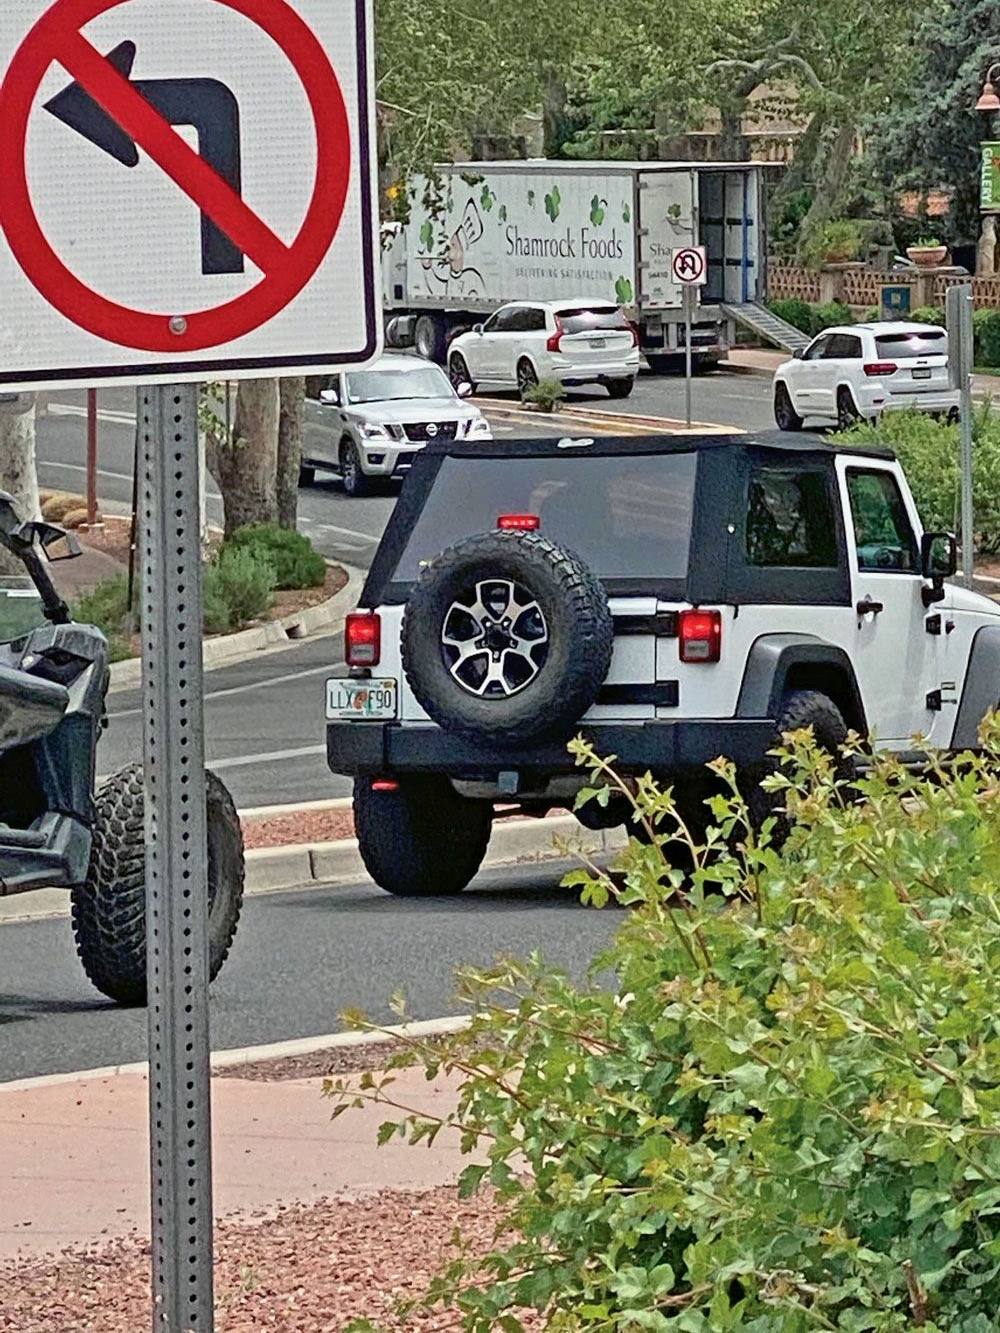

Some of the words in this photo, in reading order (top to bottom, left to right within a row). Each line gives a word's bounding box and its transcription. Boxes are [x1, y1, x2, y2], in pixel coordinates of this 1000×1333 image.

[981, 147, 993, 203] GALLERY
[505, 224, 576, 258] Shamrock
[581, 227, 623, 259] Foods
